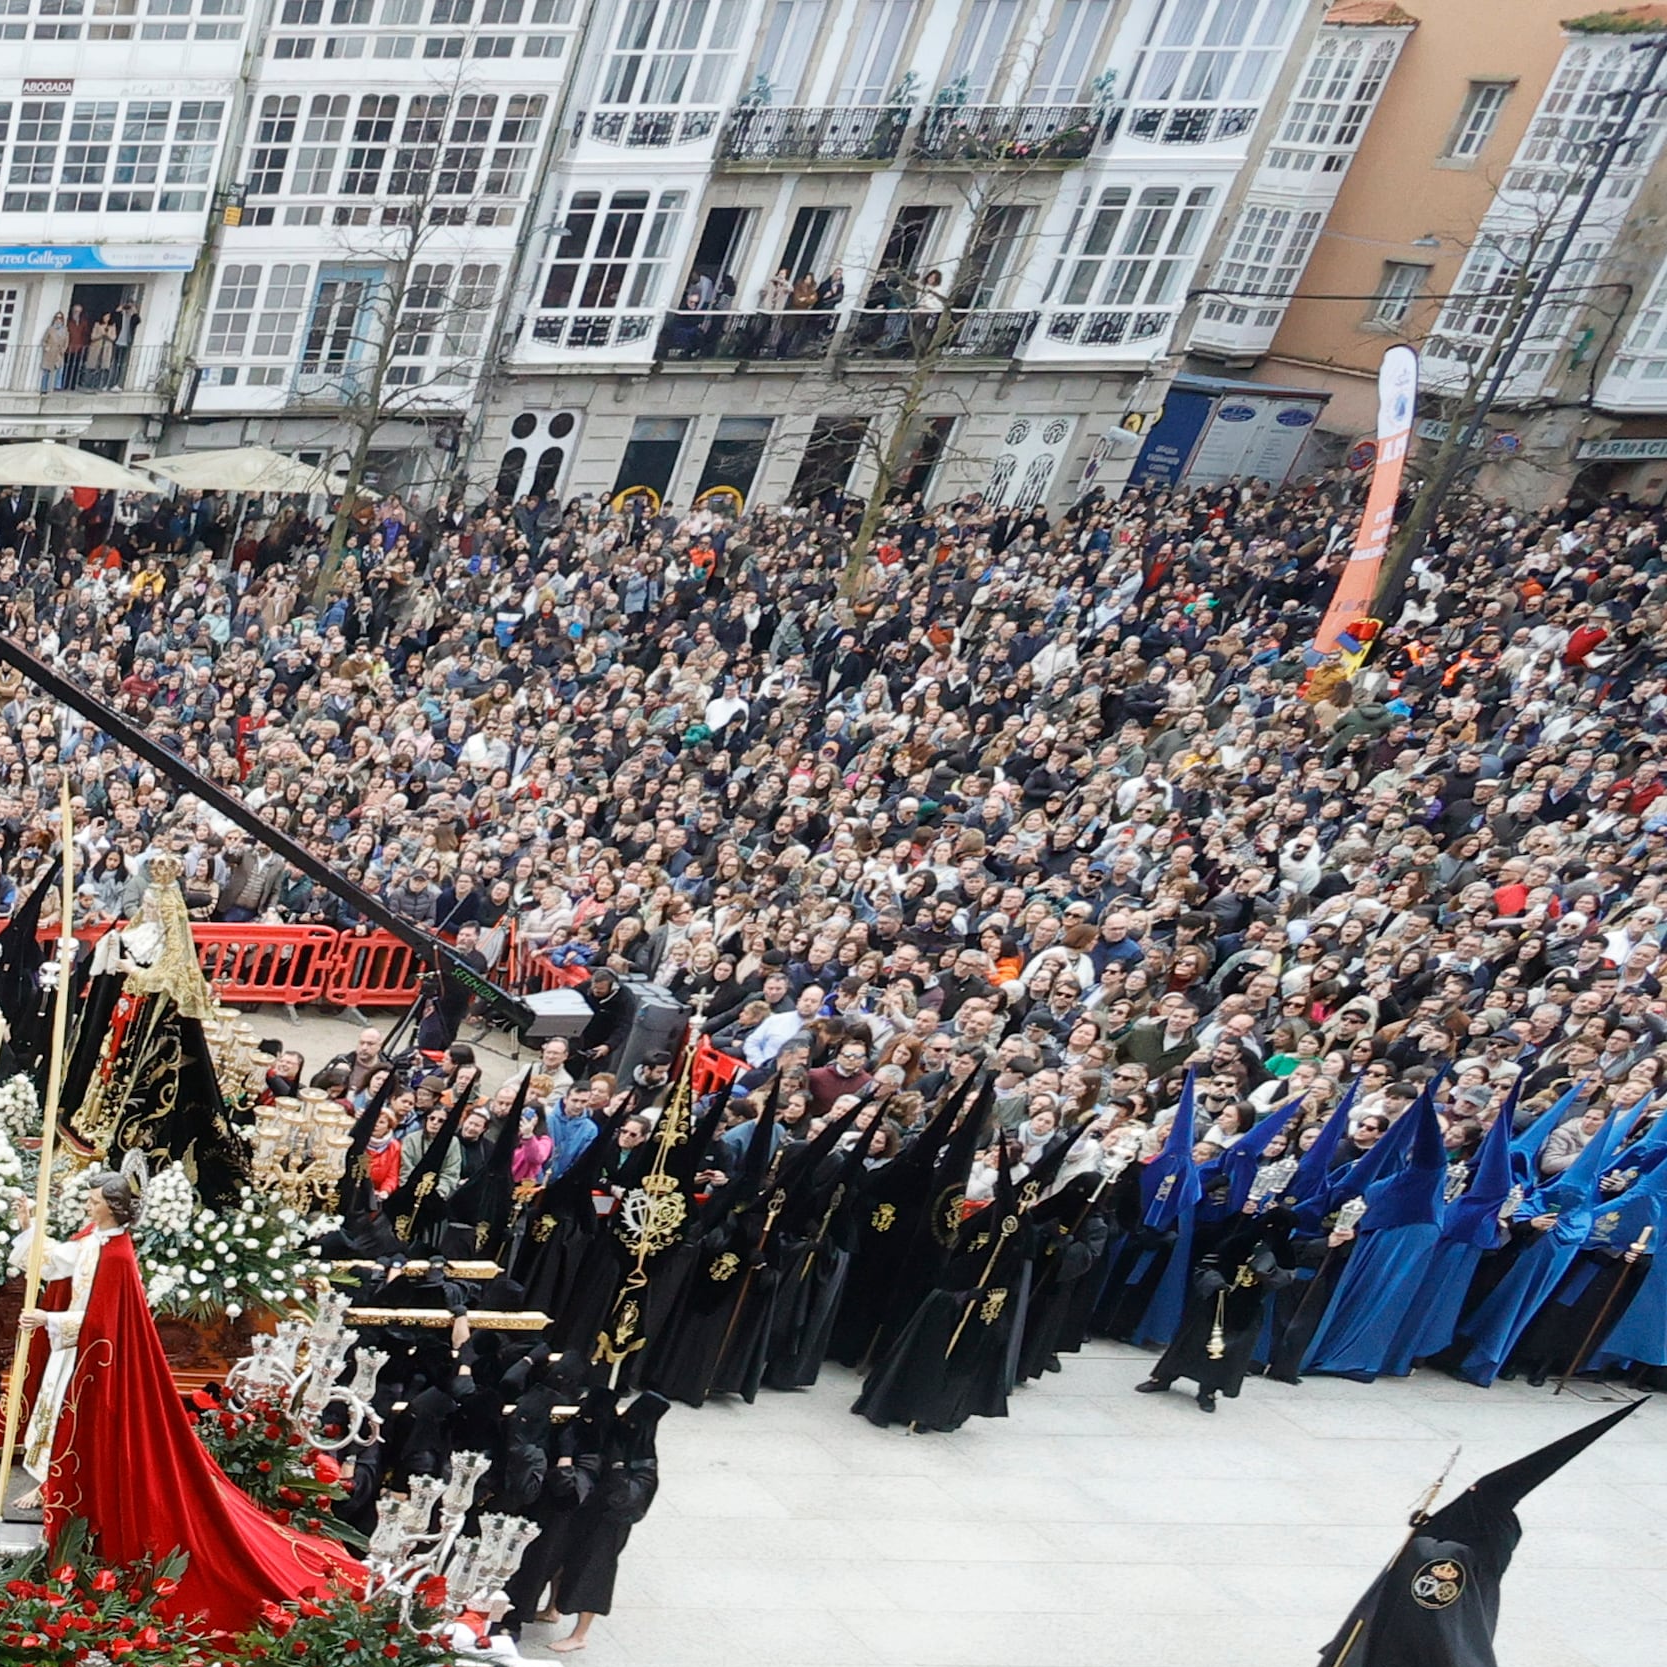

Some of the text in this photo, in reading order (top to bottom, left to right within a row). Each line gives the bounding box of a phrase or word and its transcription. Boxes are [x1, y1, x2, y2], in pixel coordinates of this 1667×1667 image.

[23, 82, 72, 92] ABOGADA
[27, 251, 72, 267] Gallego
[1587, 440, 1667, 456] FARMACI
